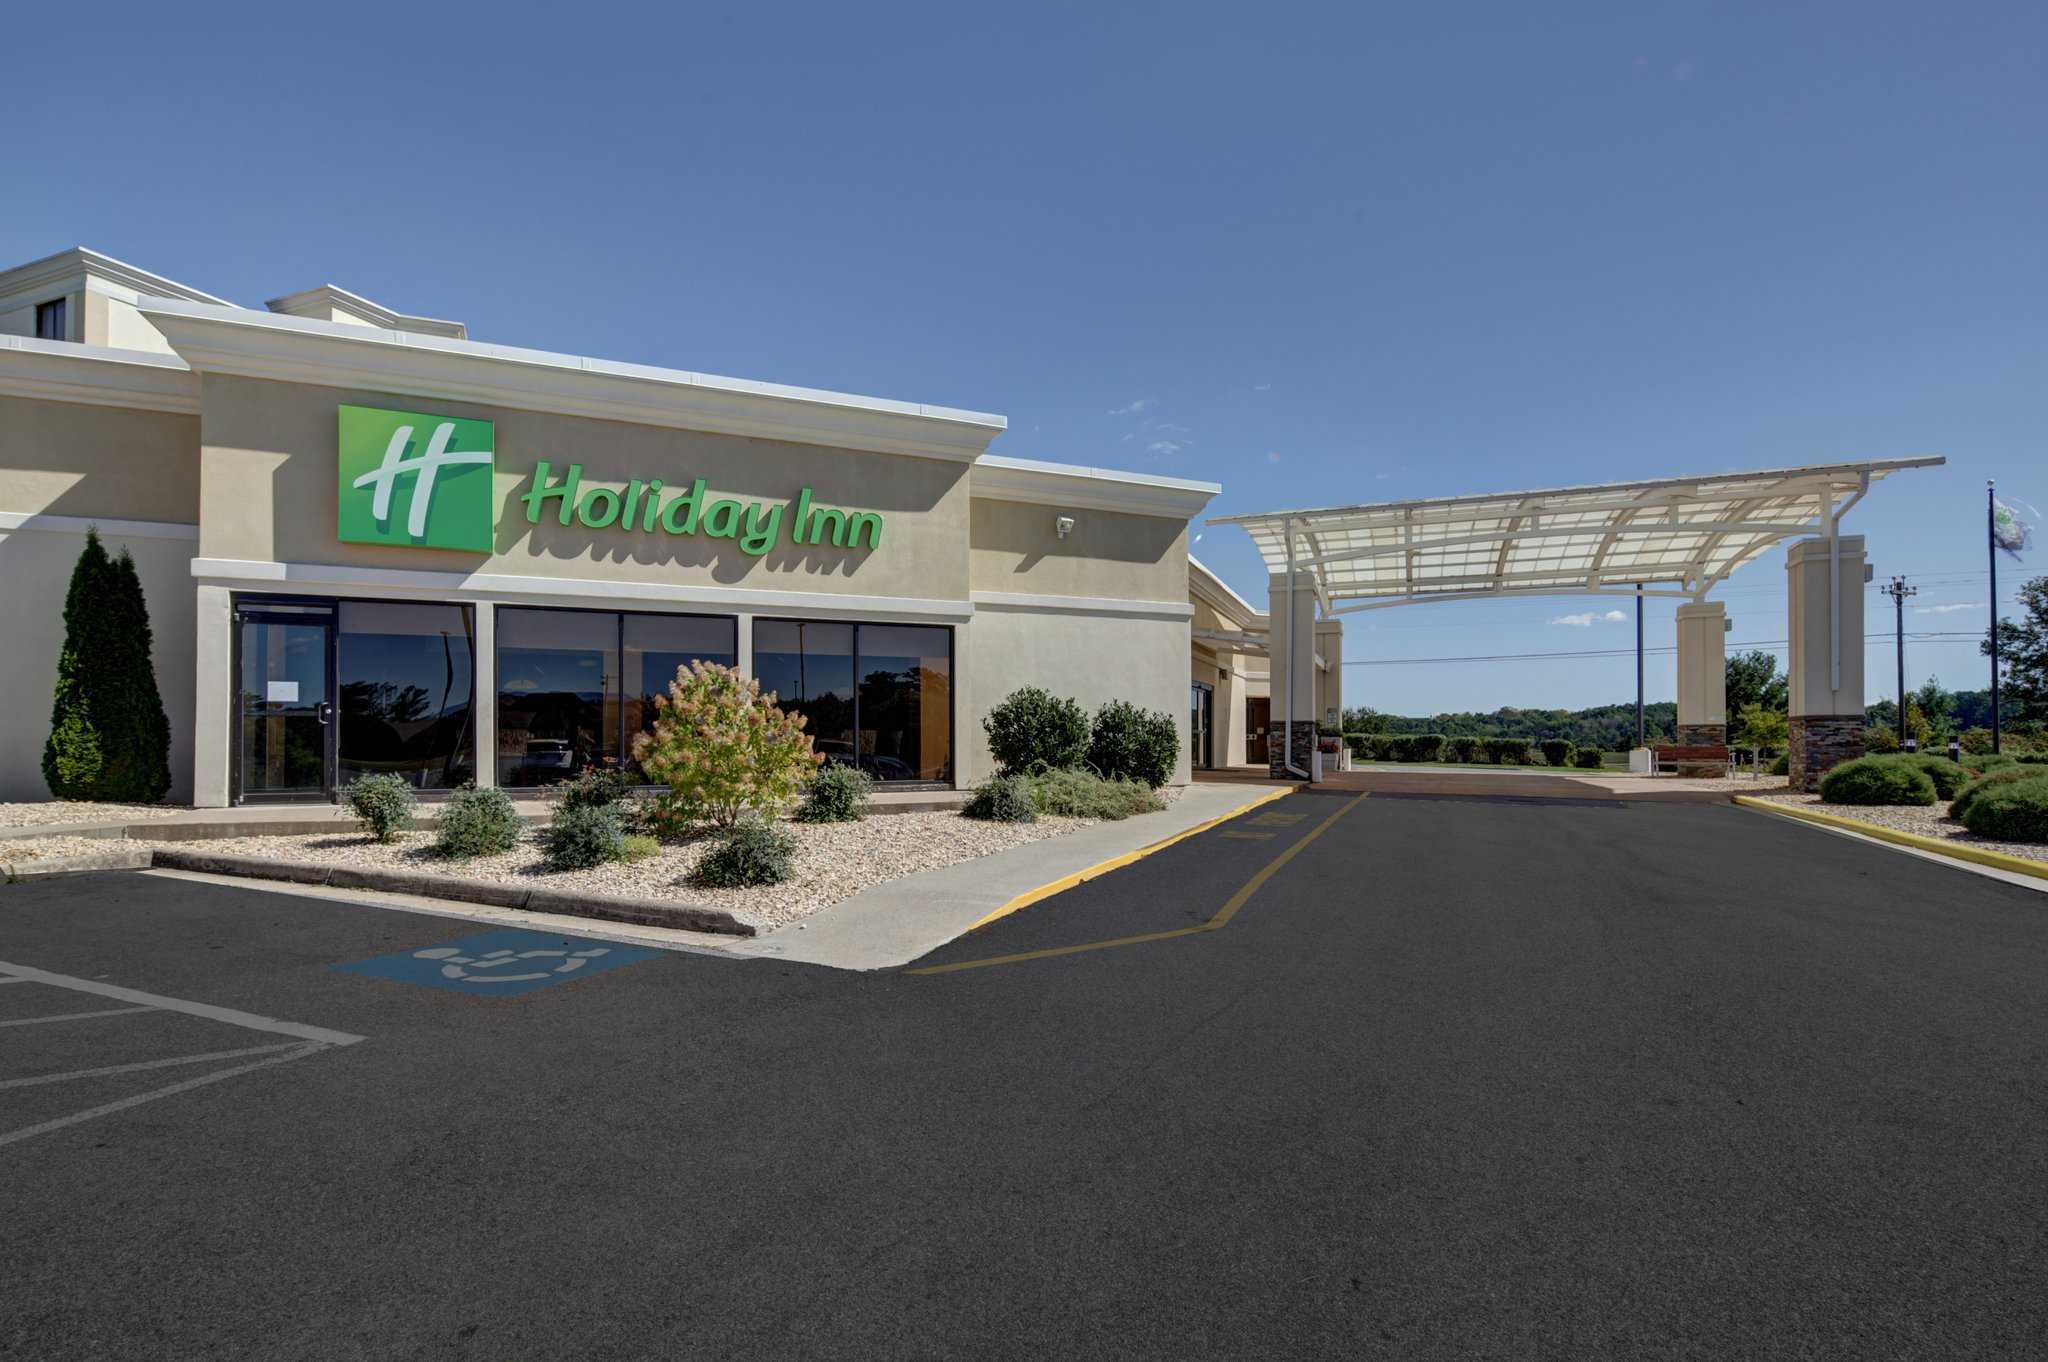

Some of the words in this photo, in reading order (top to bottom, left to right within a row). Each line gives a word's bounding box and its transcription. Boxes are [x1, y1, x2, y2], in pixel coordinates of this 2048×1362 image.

[353, 422, 493, 538] H
[520, 460, 785, 556] Holiday
[792, 486, 884, 551] Inn
